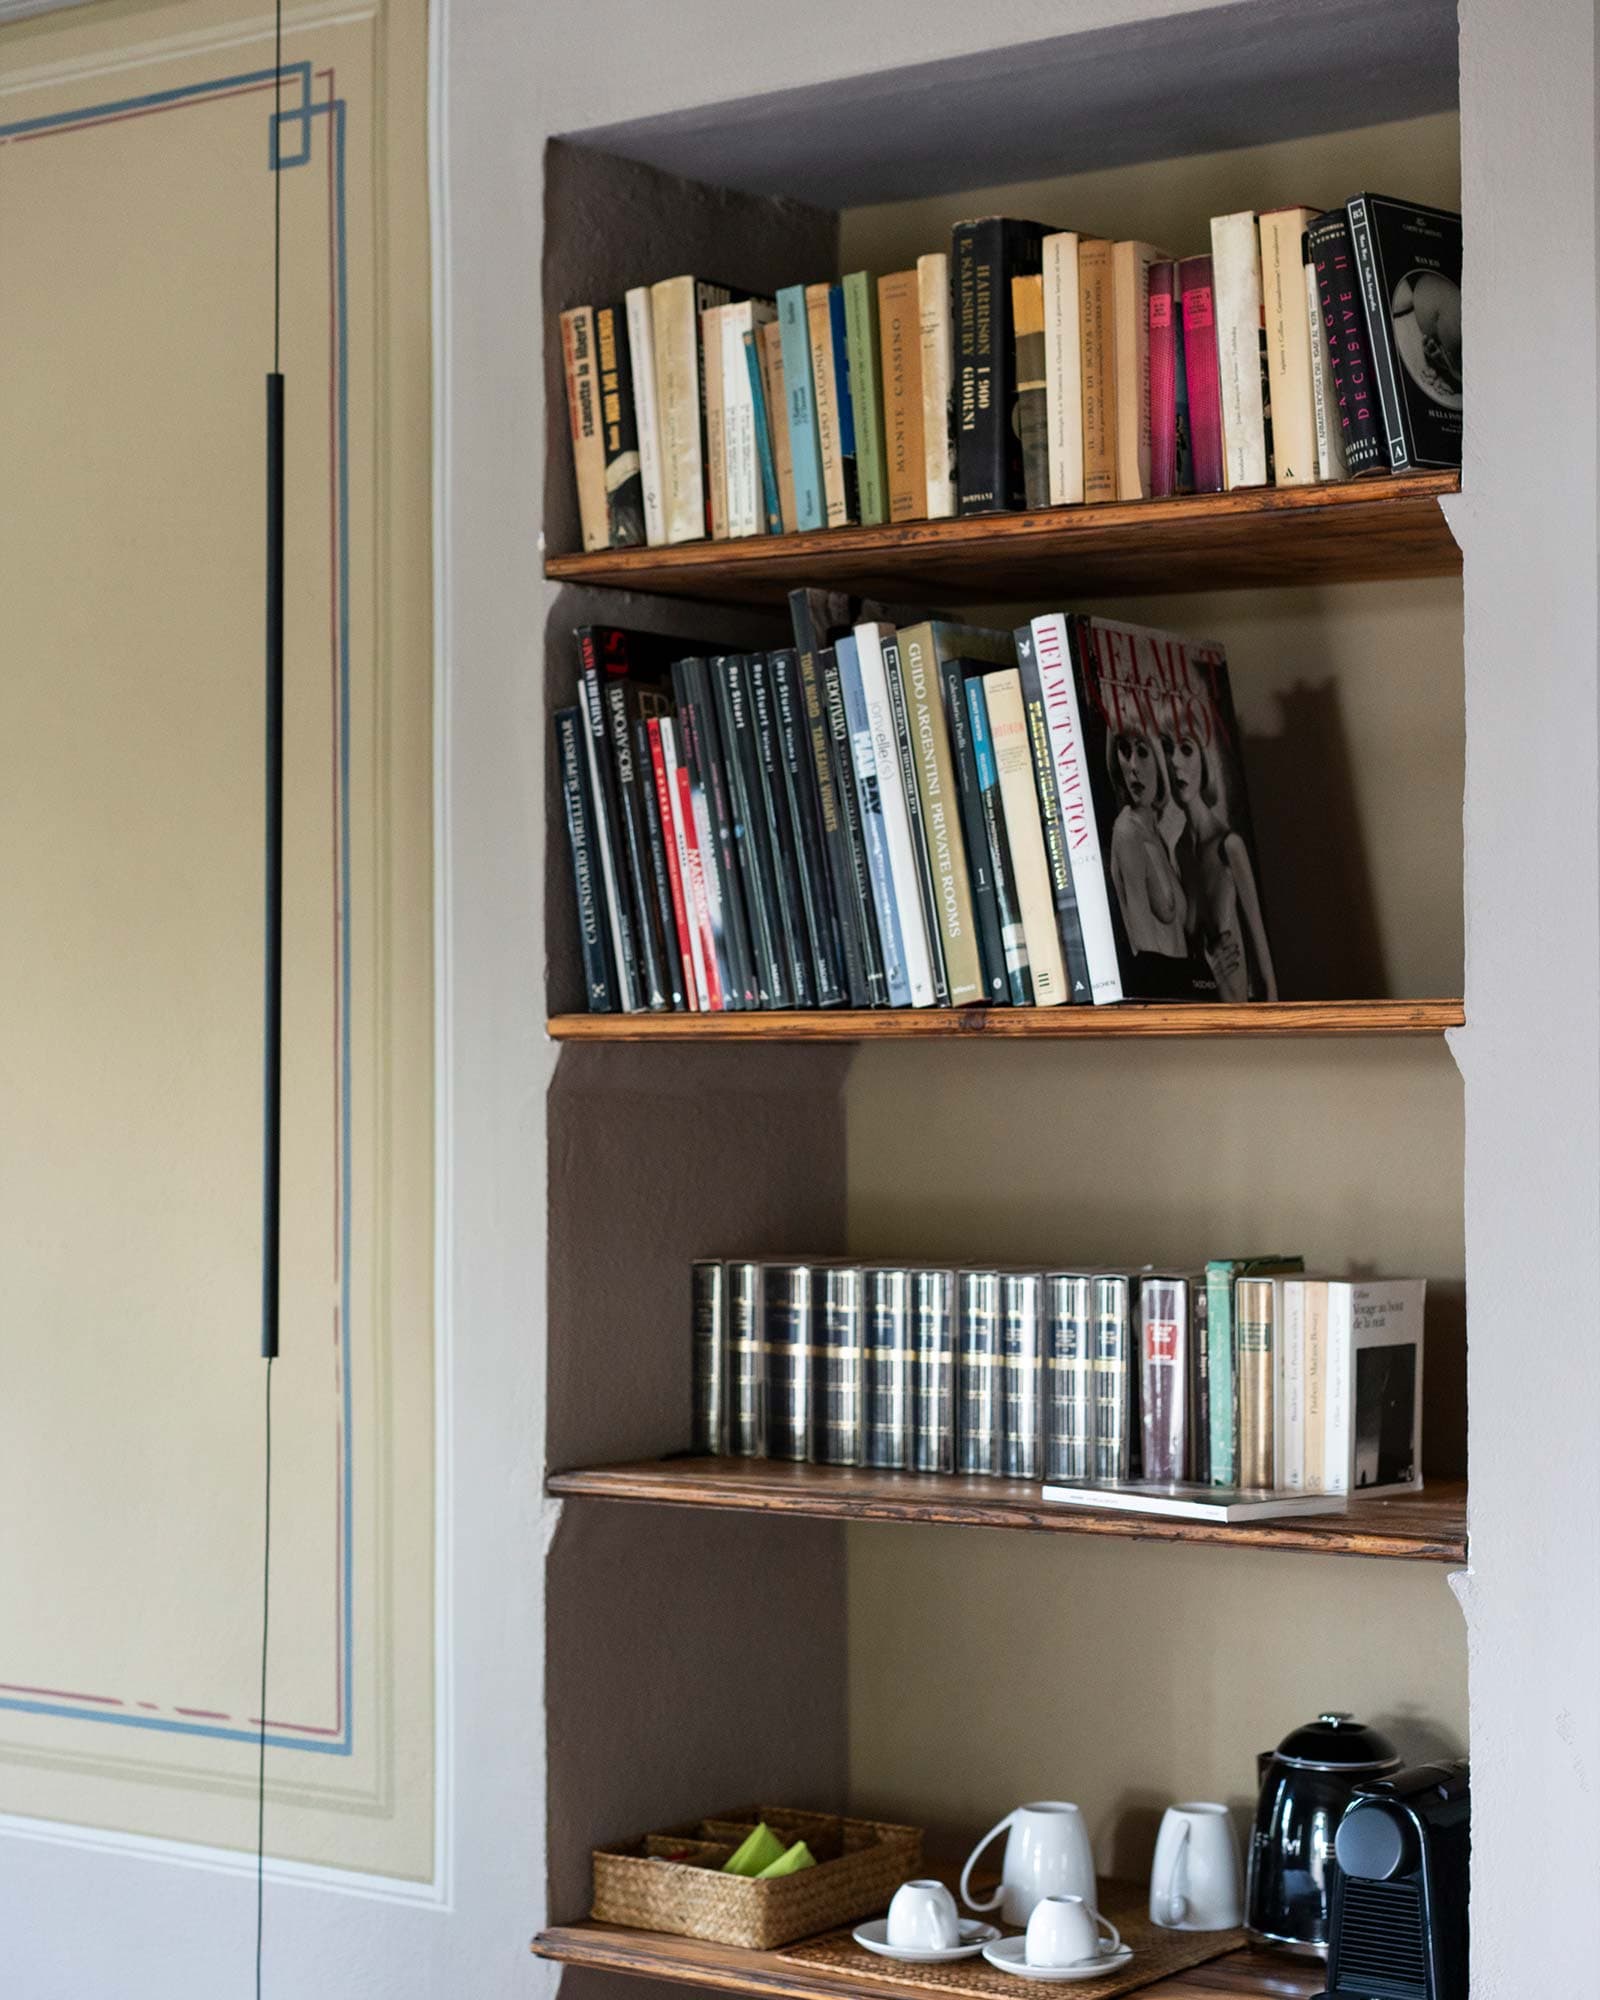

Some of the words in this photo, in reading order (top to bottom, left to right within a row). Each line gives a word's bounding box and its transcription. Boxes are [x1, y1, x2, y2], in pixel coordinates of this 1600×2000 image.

[961, 257, 975, 356] SALISBURY
[977, 264, 991, 355] HARRISON
[1084, 289, 1092, 323] FLOW
[892, 318, 903, 397] CASSINO
[1085, 330, 1094, 369] SCAPA
[1316, 261, 1350, 428] BATTAGLIE
[1339, 290, 1370, 420] DECISIVE
[575, 363, 590, 377] la
[977, 366, 991, 375] I
[1086, 375, 1094, 389] DI
[579, 380, 595, 437] stanotte
[962, 366, 976, 431] GIORNI
[978, 379, 991, 410] 900
[1087, 396, 1095, 430] TORO
[821, 411, 831, 451] CAPO
[896, 408, 905, 473] MONTE
[825, 459, 832, 470] IL
[725, 666, 740, 689] Roy
[749, 663, 765, 687] Roy
[772, 660, 788, 684] Roy
[799, 652, 816, 683] TONY
[906, 642, 927, 699] GUIDO
[1077, 623, 1223, 699] HELMUT
[730, 689, 746, 728] Stuart
[754, 687, 771, 726] Stuart
[776, 684, 794, 723] Stuart
[804, 684, 820, 718] WARD
[822, 666, 849, 741] CATALOGUE
[946, 674, 963, 721] Calendario
[969, 688, 978, 714] HELMUT
[867, 700, 895, 782] jonvelle(s)
[914, 702, 941, 795] ARGENTINI
[953, 721, 967, 750] Pirelli
[973, 715, 983, 741] NEWTON
[1036, 625, 1072, 736] HELMUT
[1054, 733, 1090, 850] NEWTON
[562, 719, 580, 791] SUPERSTAR
[811, 726, 830, 782] TABLEAUX
[851, 730, 877, 778] MAN
[819, 783, 837, 832] VIVANTS
[1027, 701, 1049, 768] PLAYBOY
[1038, 768, 1058, 827] HELMUT
[1048, 828, 1069, 890] NEWTON
[570, 794, 586, 846] PIRELLI
[929, 803, 952, 872] PRIVATE
[576, 848, 597, 943] CALENDARIO
[939, 875, 961, 938] ROOMS
[1353, 1303, 1377, 1318] Voyage
[1387, 1301, 1404, 1313] bout
[1353, 1316, 1361, 1329] de
[1372, 1317, 1385, 1328] nuit
[1254, 1826, 1336, 1860] SME
